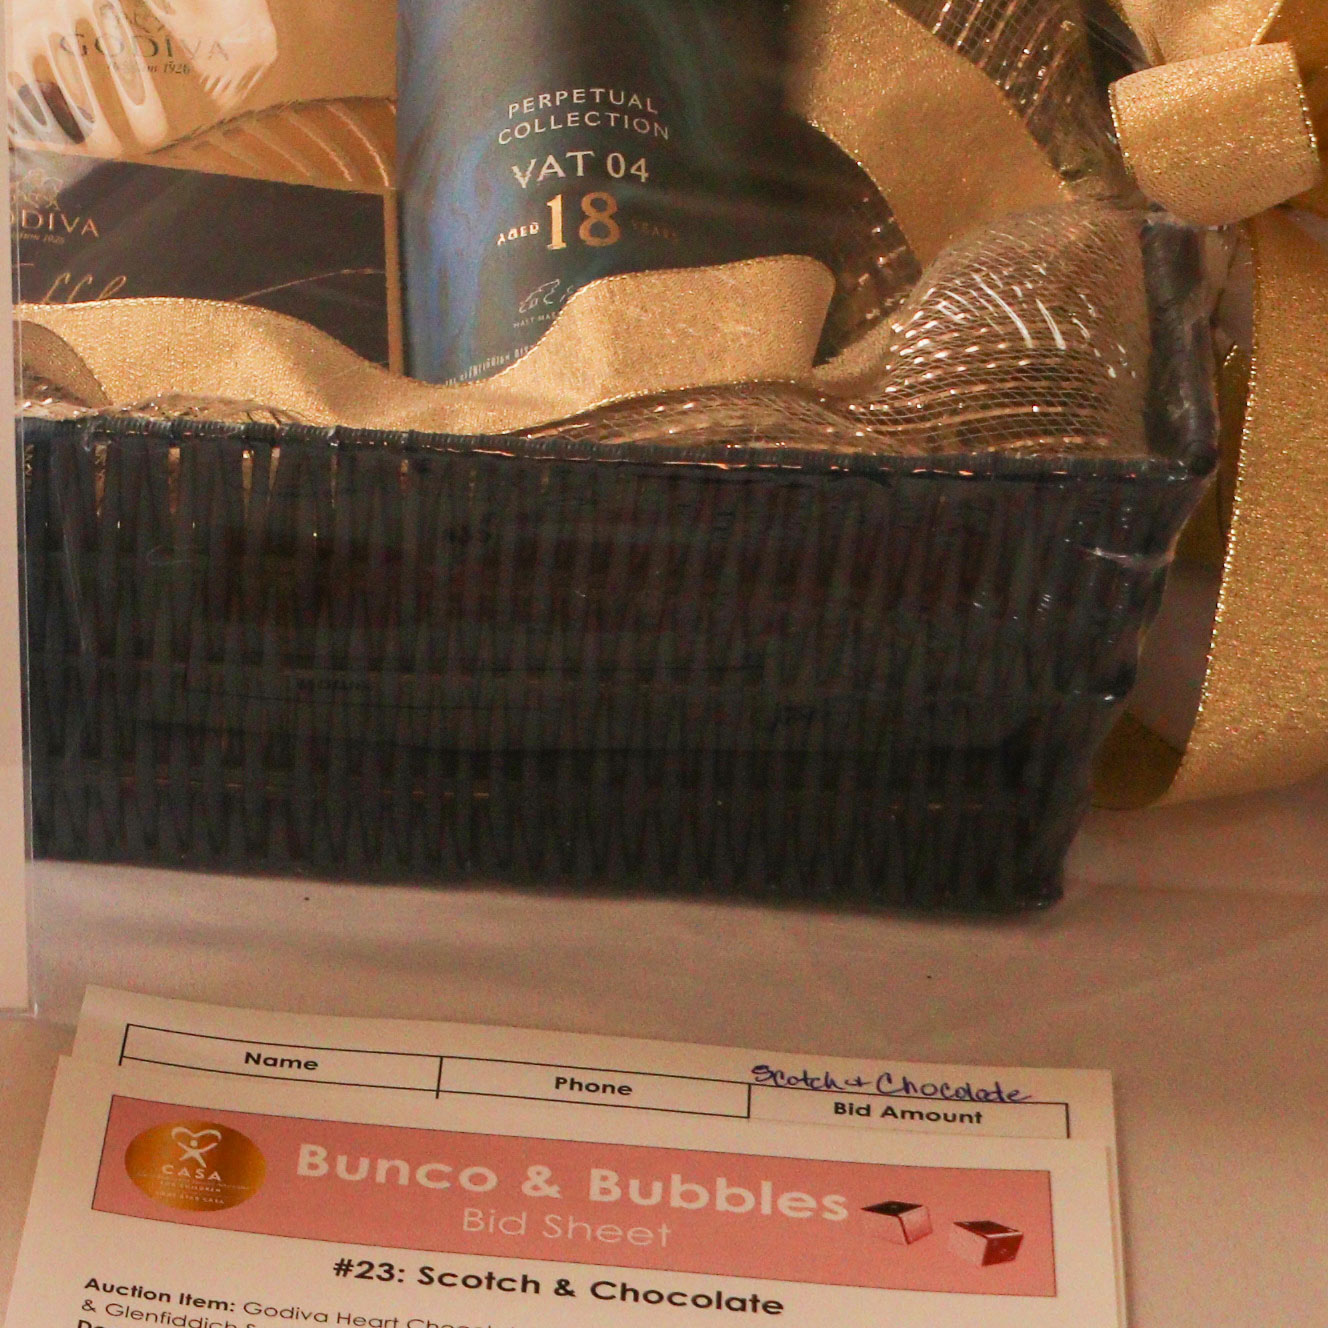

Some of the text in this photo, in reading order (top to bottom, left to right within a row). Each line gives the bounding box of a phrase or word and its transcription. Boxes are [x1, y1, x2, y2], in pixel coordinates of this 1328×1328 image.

[506, 87, 660, 120] PERPETUAL
[497, 111, 671, 146] COLLECTION
[511, 151, 649, 190] VAT 04
[495, 191, 622, 251] AGED 18
[243, 1050, 983, 1125] Name Phone Bid Amount
[161, 1164, 222, 1182] CASA
[295, 1142, 849, 1222] Bunco & Bubbles
[462, 1207, 672, 1248] Bid Sheet
[83, 1277, 171, 1304] Auction
[178, 1291, 236, 1312] Item:
[243, 1301, 329, 1323] Godiva
[336, 1311, 398, 1328] Heart
[333, 1257, 785, 1316] #23: Scotch & Chocolate
[81, 1298, 97, 1313] &
[105, 1302, 237, 1328] Glenfiddich
